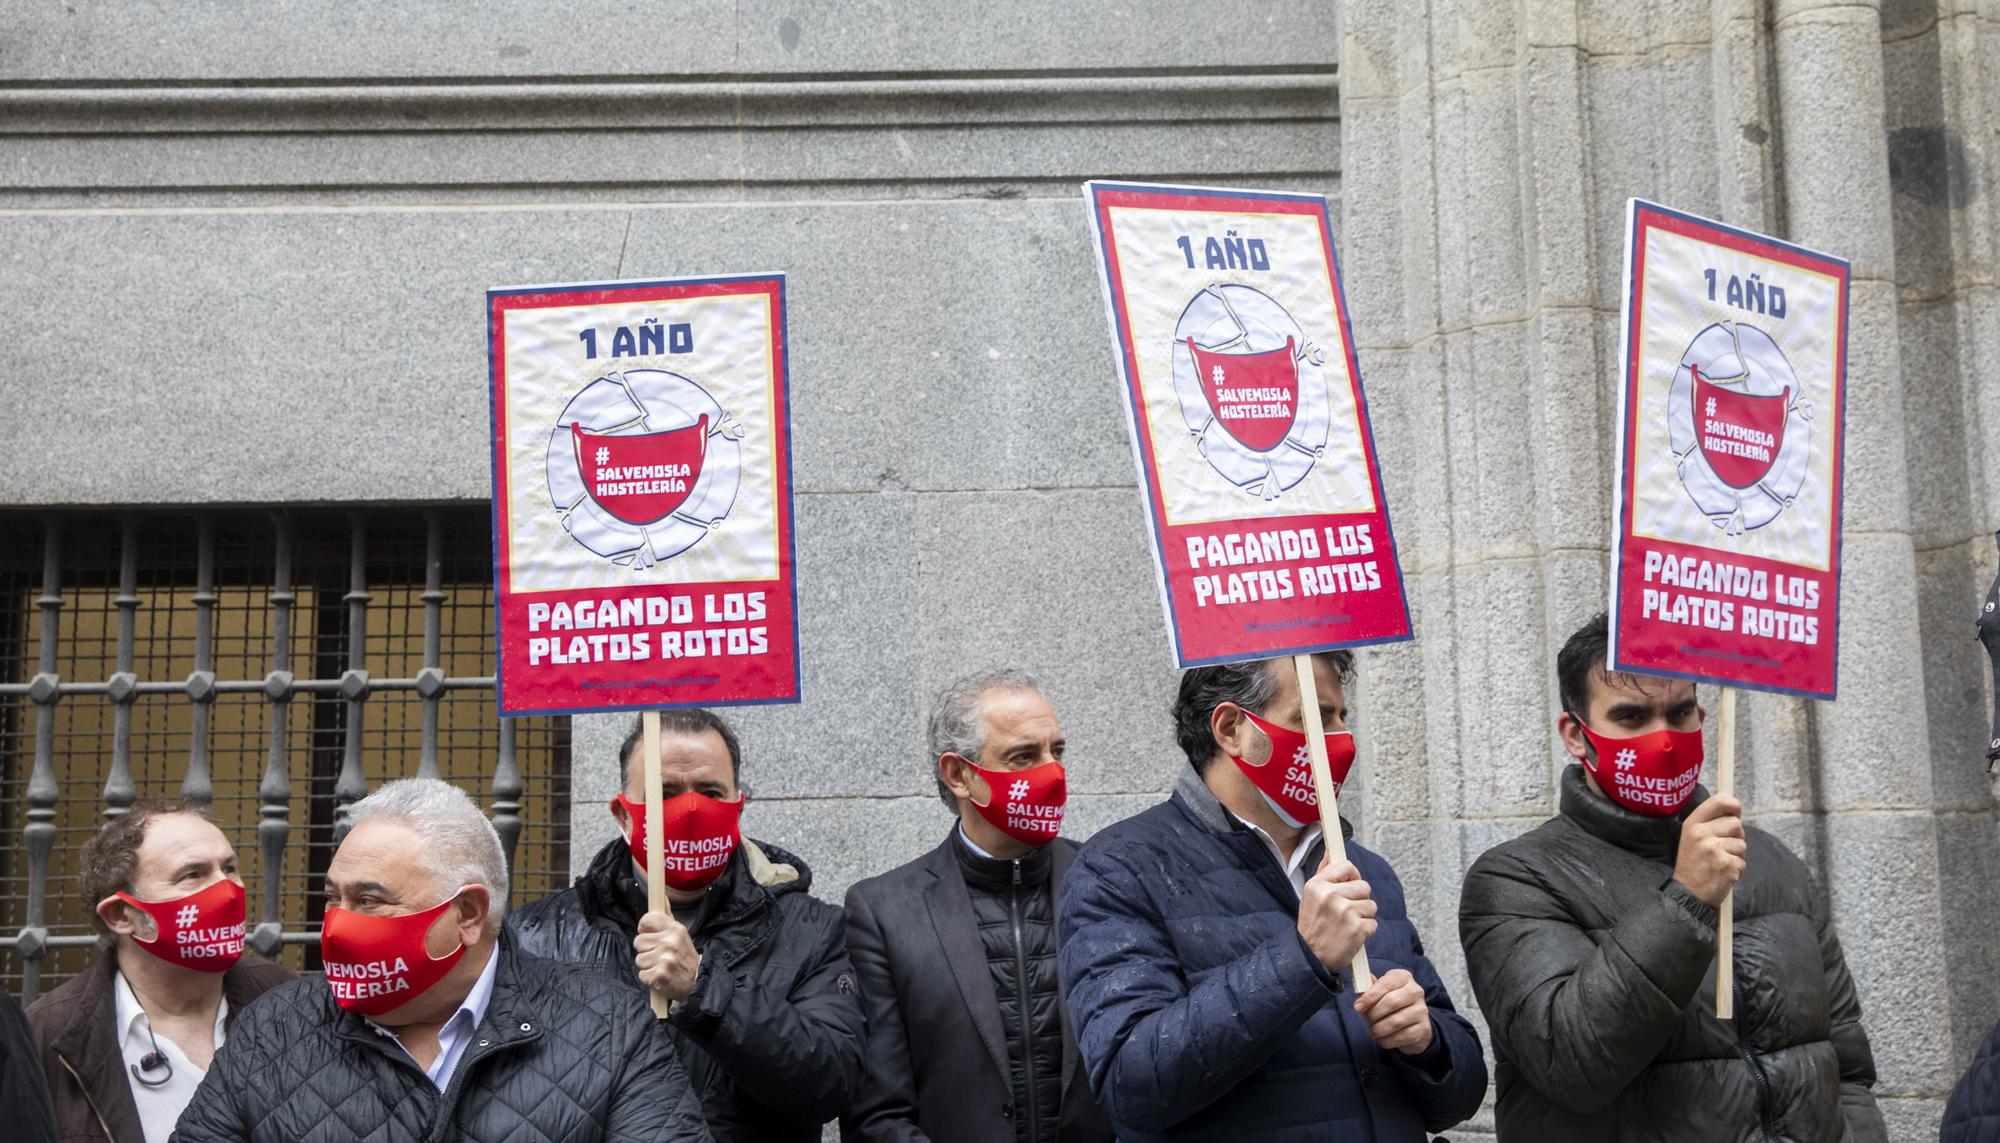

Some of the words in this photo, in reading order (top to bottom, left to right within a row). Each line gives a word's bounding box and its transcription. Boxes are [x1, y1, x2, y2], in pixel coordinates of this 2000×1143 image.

[1177, 235, 1196, 269] 1
[1205, 230, 1270, 271] AÑO
[1704, 268, 1717, 301] 1
[1726, 273, 1787, 319] AÑO
[579, 328, 597, 359] 1
[612, 318, 694, 358] AÑO
[1212, 365, 1225, 385] #
[1217, 386, 1291, 404] SALVEMOSLA
[1705, 397, 1717, 417] #
[1220, 400, 1291, 419] HOSTELERÍA
[1705, 419, 1775, 447] SALVEMOSLA
[595, 446, 610, 465] #
[1704, 436, 1770, 463] HOSTELERÍA
[596, 463, 691, 481] SALVEMOSLA
[596, 476, 686, 496] HOSTELERÍA
[1186, 529, 1321, 569] PAGANDO
[1326, 524, 1374, 557] LOS
[1193, 568, 1293, 607] PLATOS
[1300, 561, 1381, 596] ROTOS
[1644, 551, 1768, 600] PAGANDO
[1775, 572, 1820, 610] LOS
[528, 595, 693, 632] PAGANDO
[705, 592, 767, 622] LOS
[1643, 588, 1734, 631] PLATOS
[1742, 605, 1819, 644] ROTOS
[529, 632, 650, 666] PLATOS
[661, 627, 768, 660] ROTOS
[1615, 748, 1637, 771] #
[1008, 779, 1030, 801] #
[176, 904, 199, 929] #
